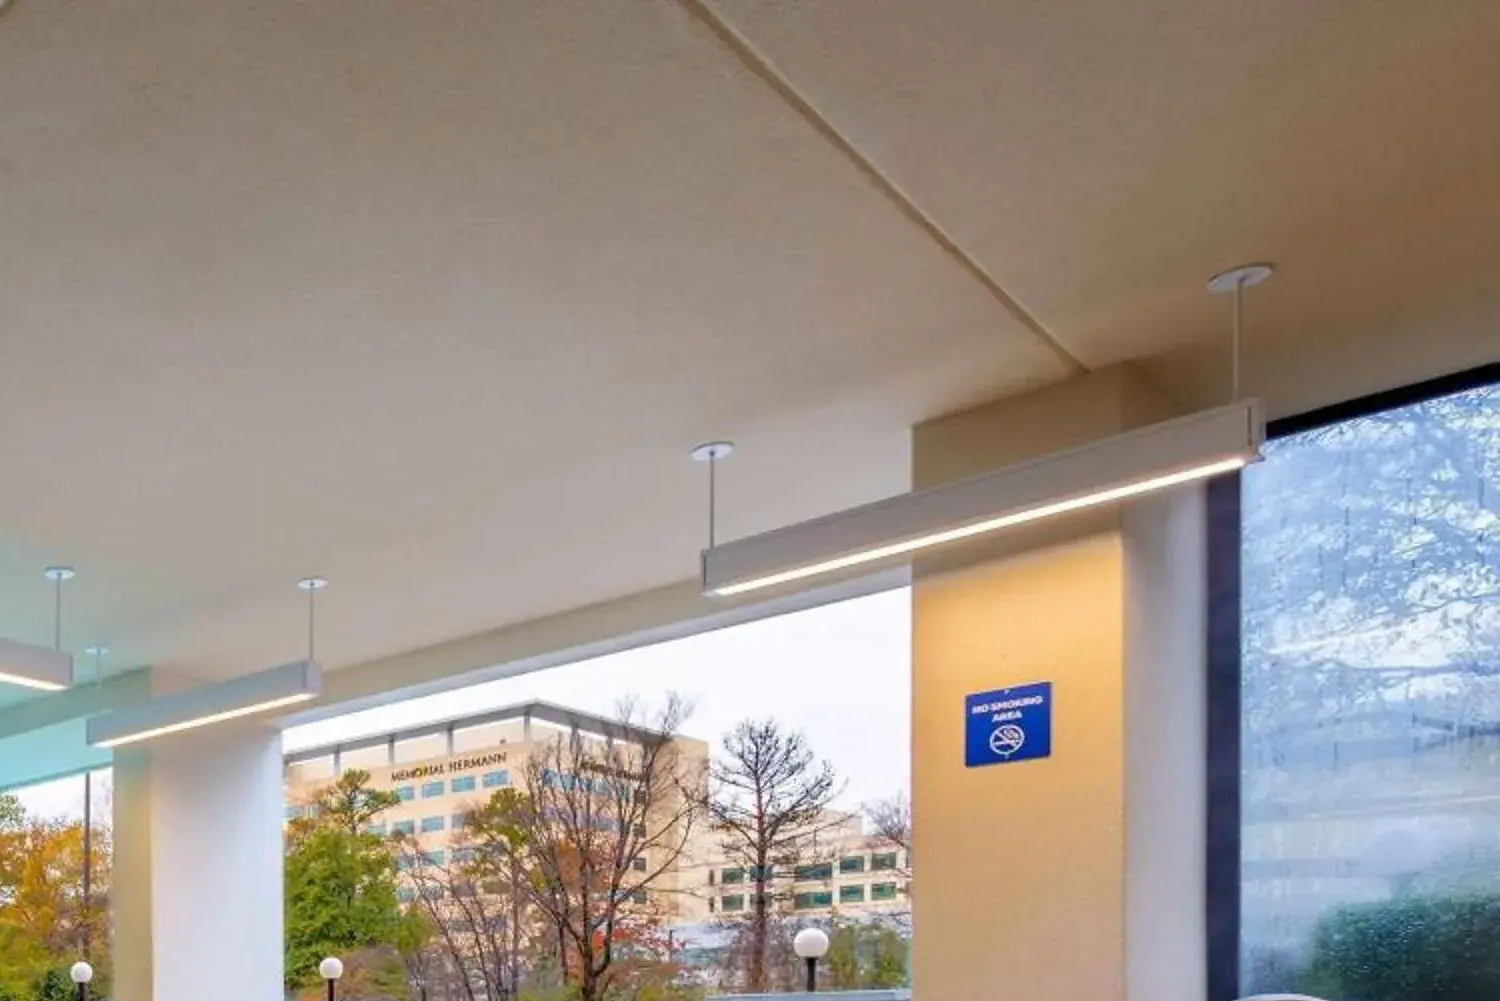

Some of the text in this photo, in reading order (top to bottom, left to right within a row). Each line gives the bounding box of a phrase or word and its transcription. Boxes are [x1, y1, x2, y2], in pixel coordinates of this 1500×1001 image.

[972, 695, 1043, 714] NO SMOKING
[992, 710, 1023, 722] AREA
[391, 752, 507, 782] MEMORIAL HERMANN
